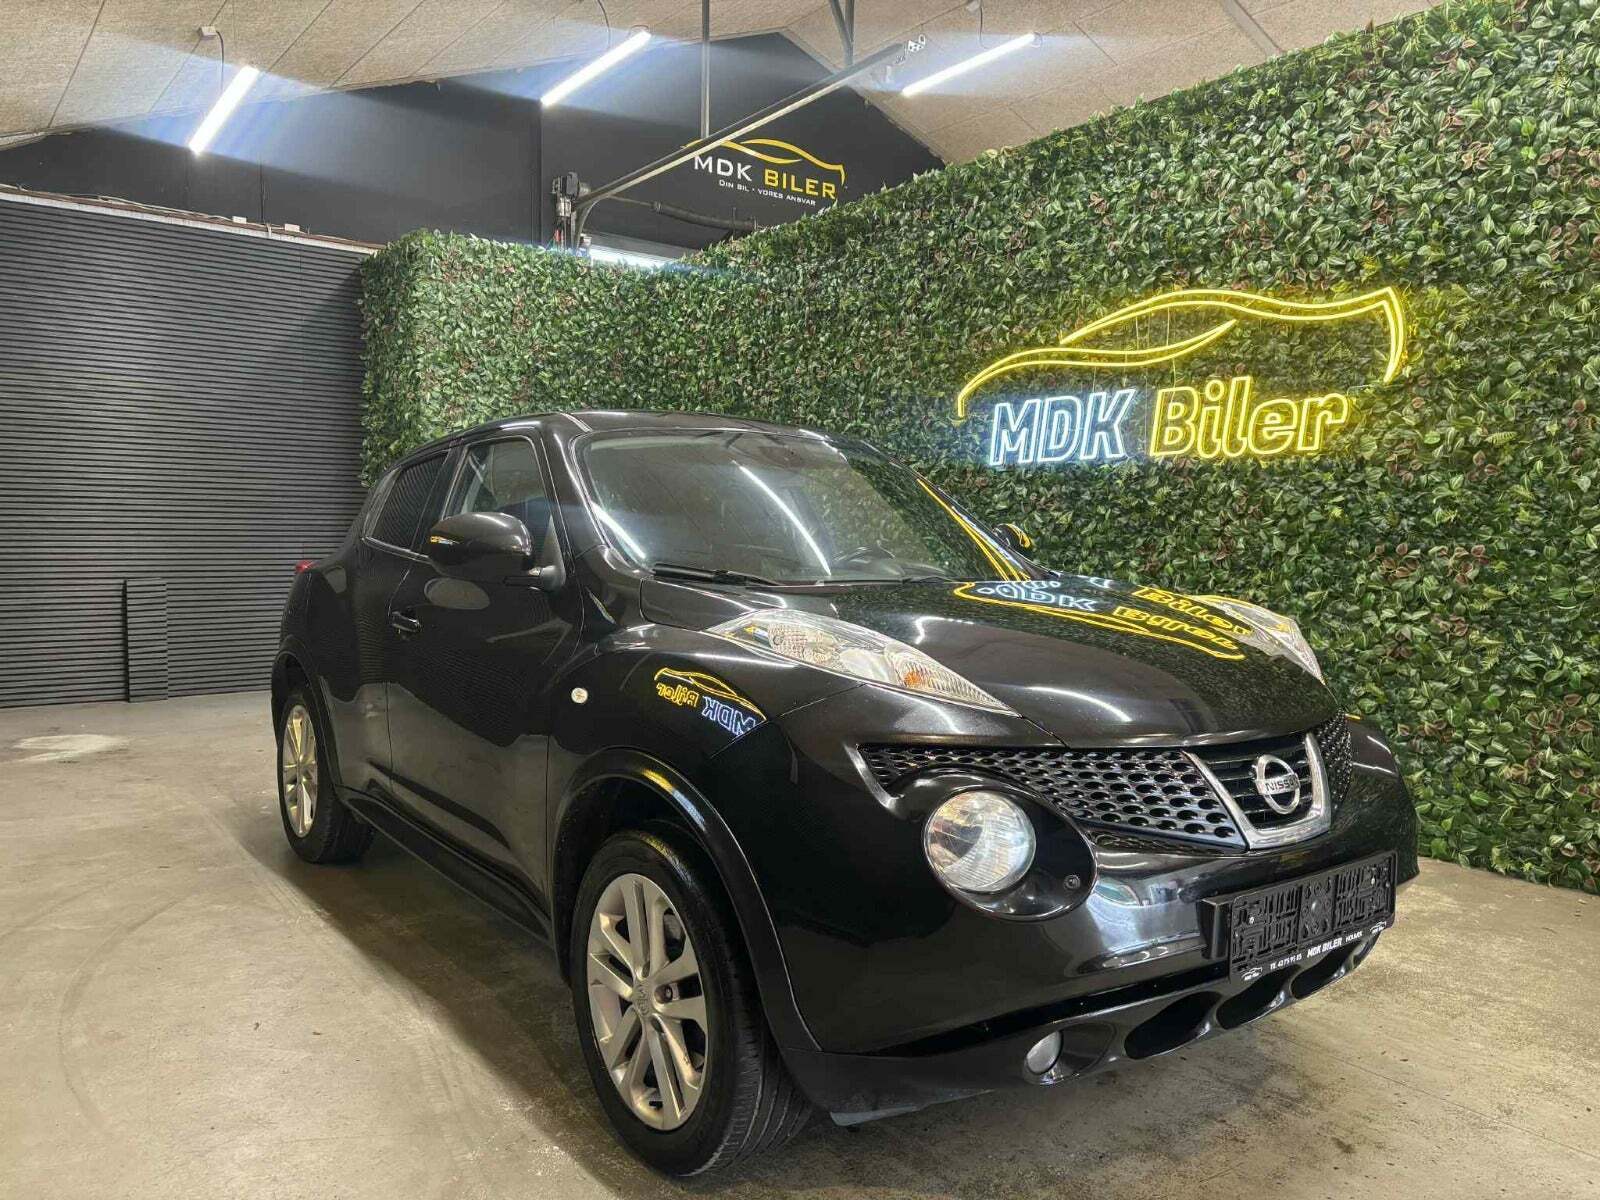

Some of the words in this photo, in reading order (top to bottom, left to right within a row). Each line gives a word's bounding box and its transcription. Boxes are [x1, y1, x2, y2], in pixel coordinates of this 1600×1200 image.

[694, 155, 753, 182] MDK
[764, 168, 837, 200] BILER
[736, 183, 750, 192] BIL
[757, 188, 784, 200] VORES
[988, 388, 1137, 467] MDK
[1149, 375, 1350, 459] Biler
